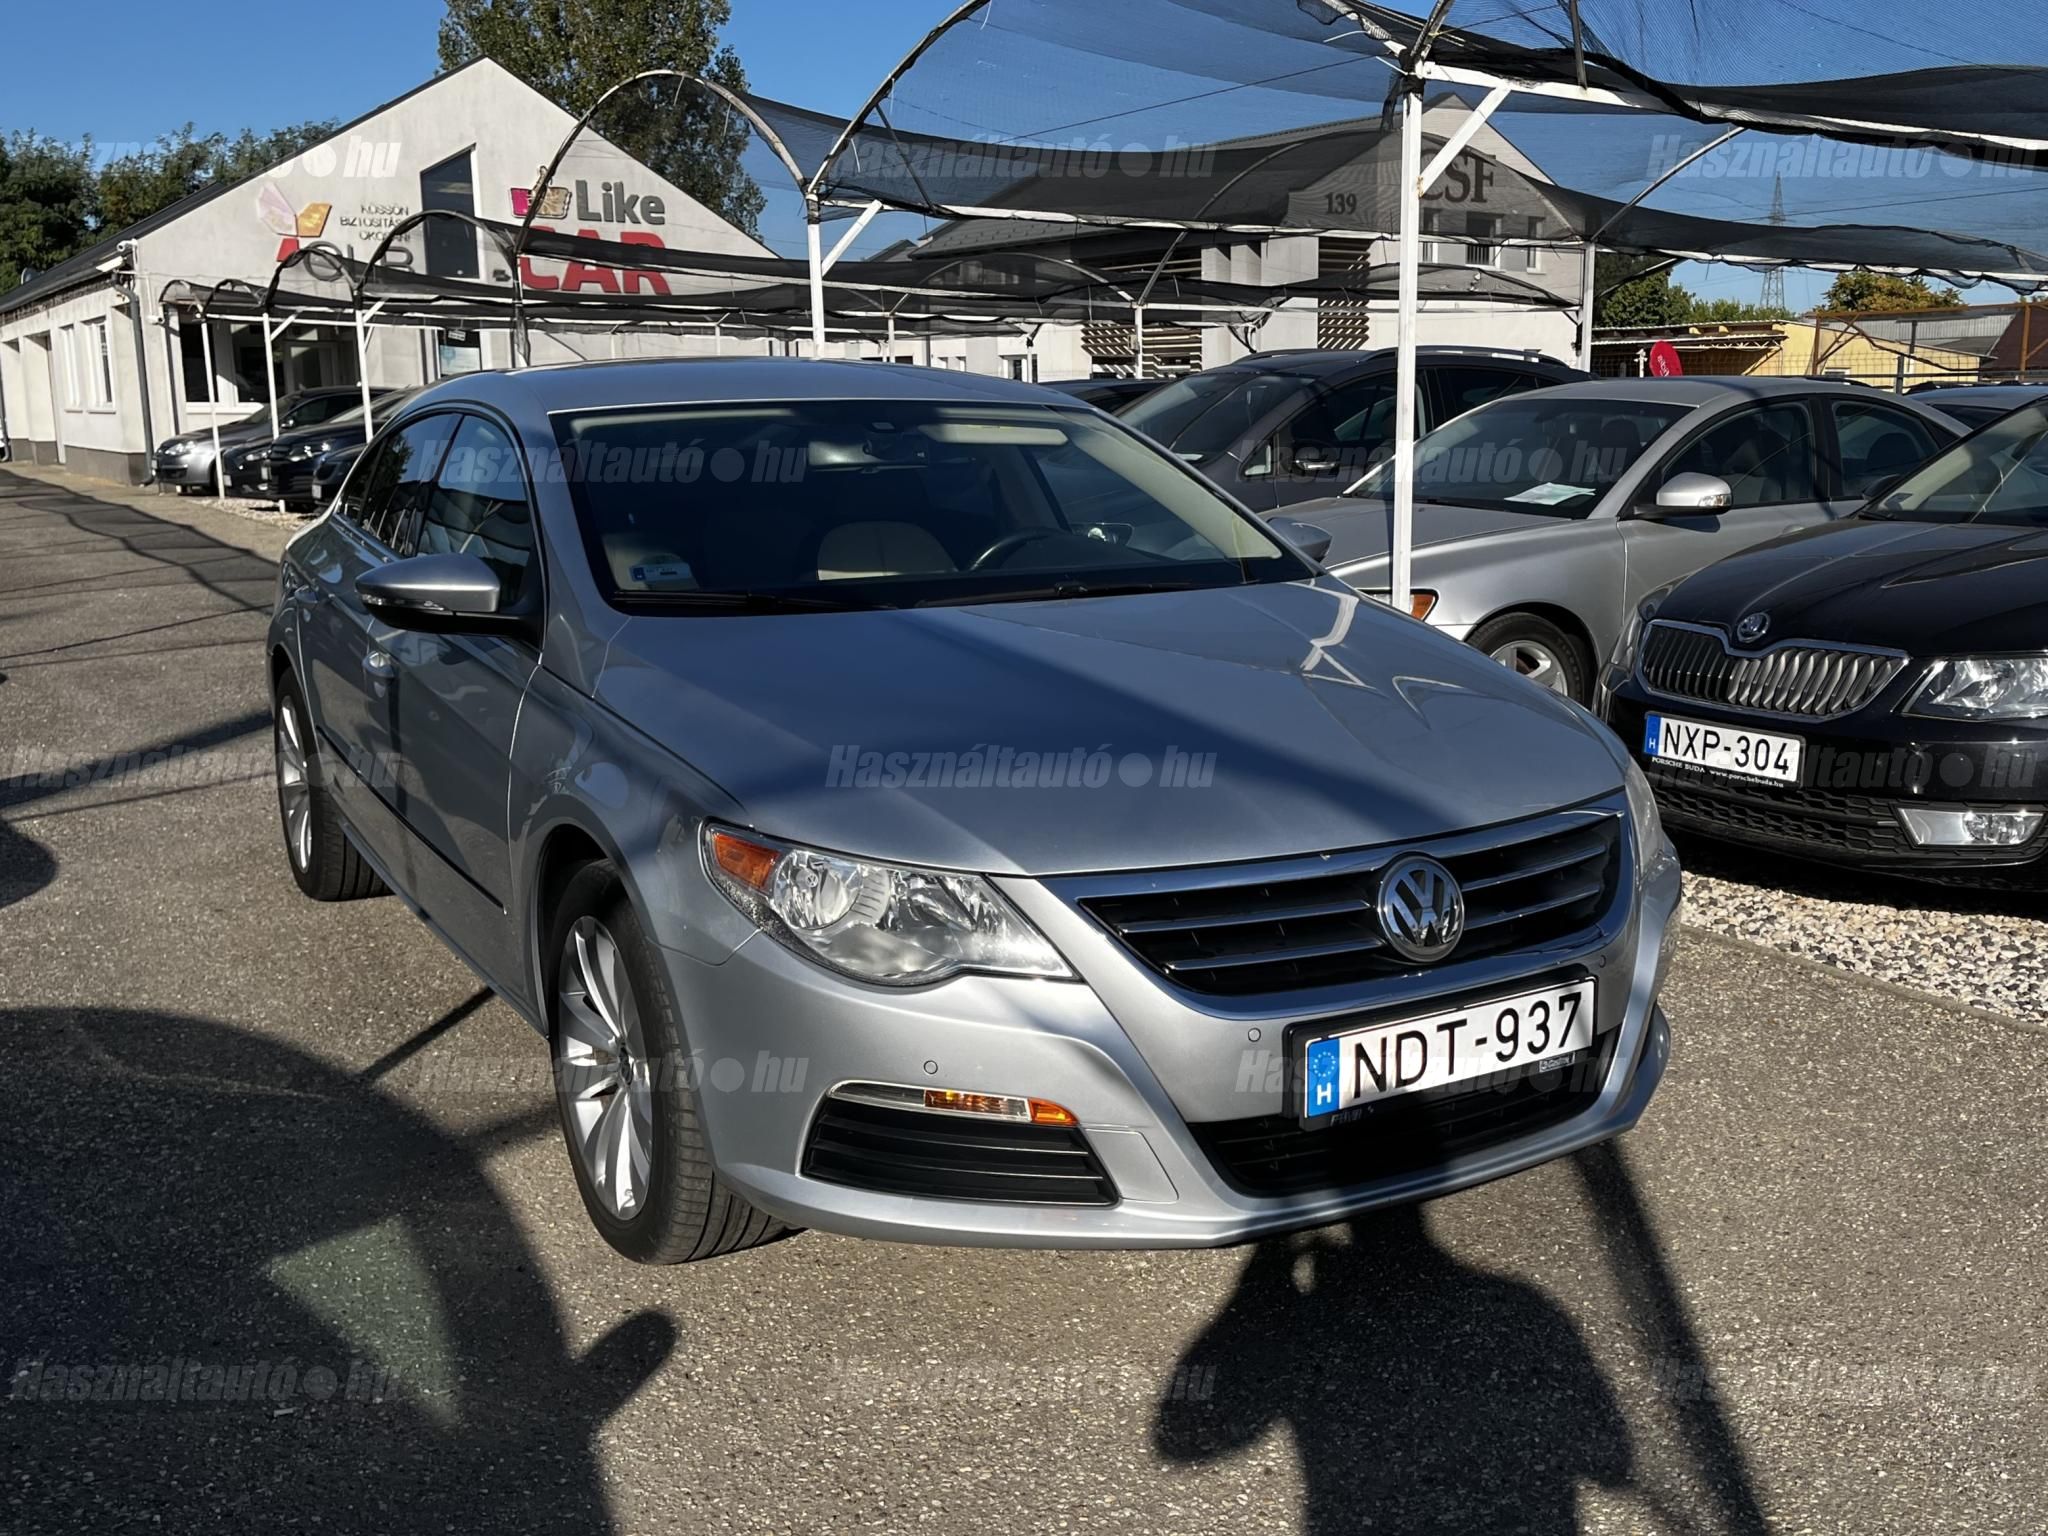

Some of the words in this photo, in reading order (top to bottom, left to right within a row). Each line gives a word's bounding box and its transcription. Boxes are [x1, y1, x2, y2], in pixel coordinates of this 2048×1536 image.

[575, 179, 666, 225] Like
[1325, 191, 1357, 215] 139
[519, 226, 673, 296] CAR
[1648, 737, 1656, 749] H
[1663, 722, 1790, 775] NXP-304
[1651, 756, 1683, 769] PORSCHE
[1684, 763, 1705, 774] BUDA
[1352, 990, 1583, 1100] NDT-937
[1316, 1082, 1332, 1105] H
